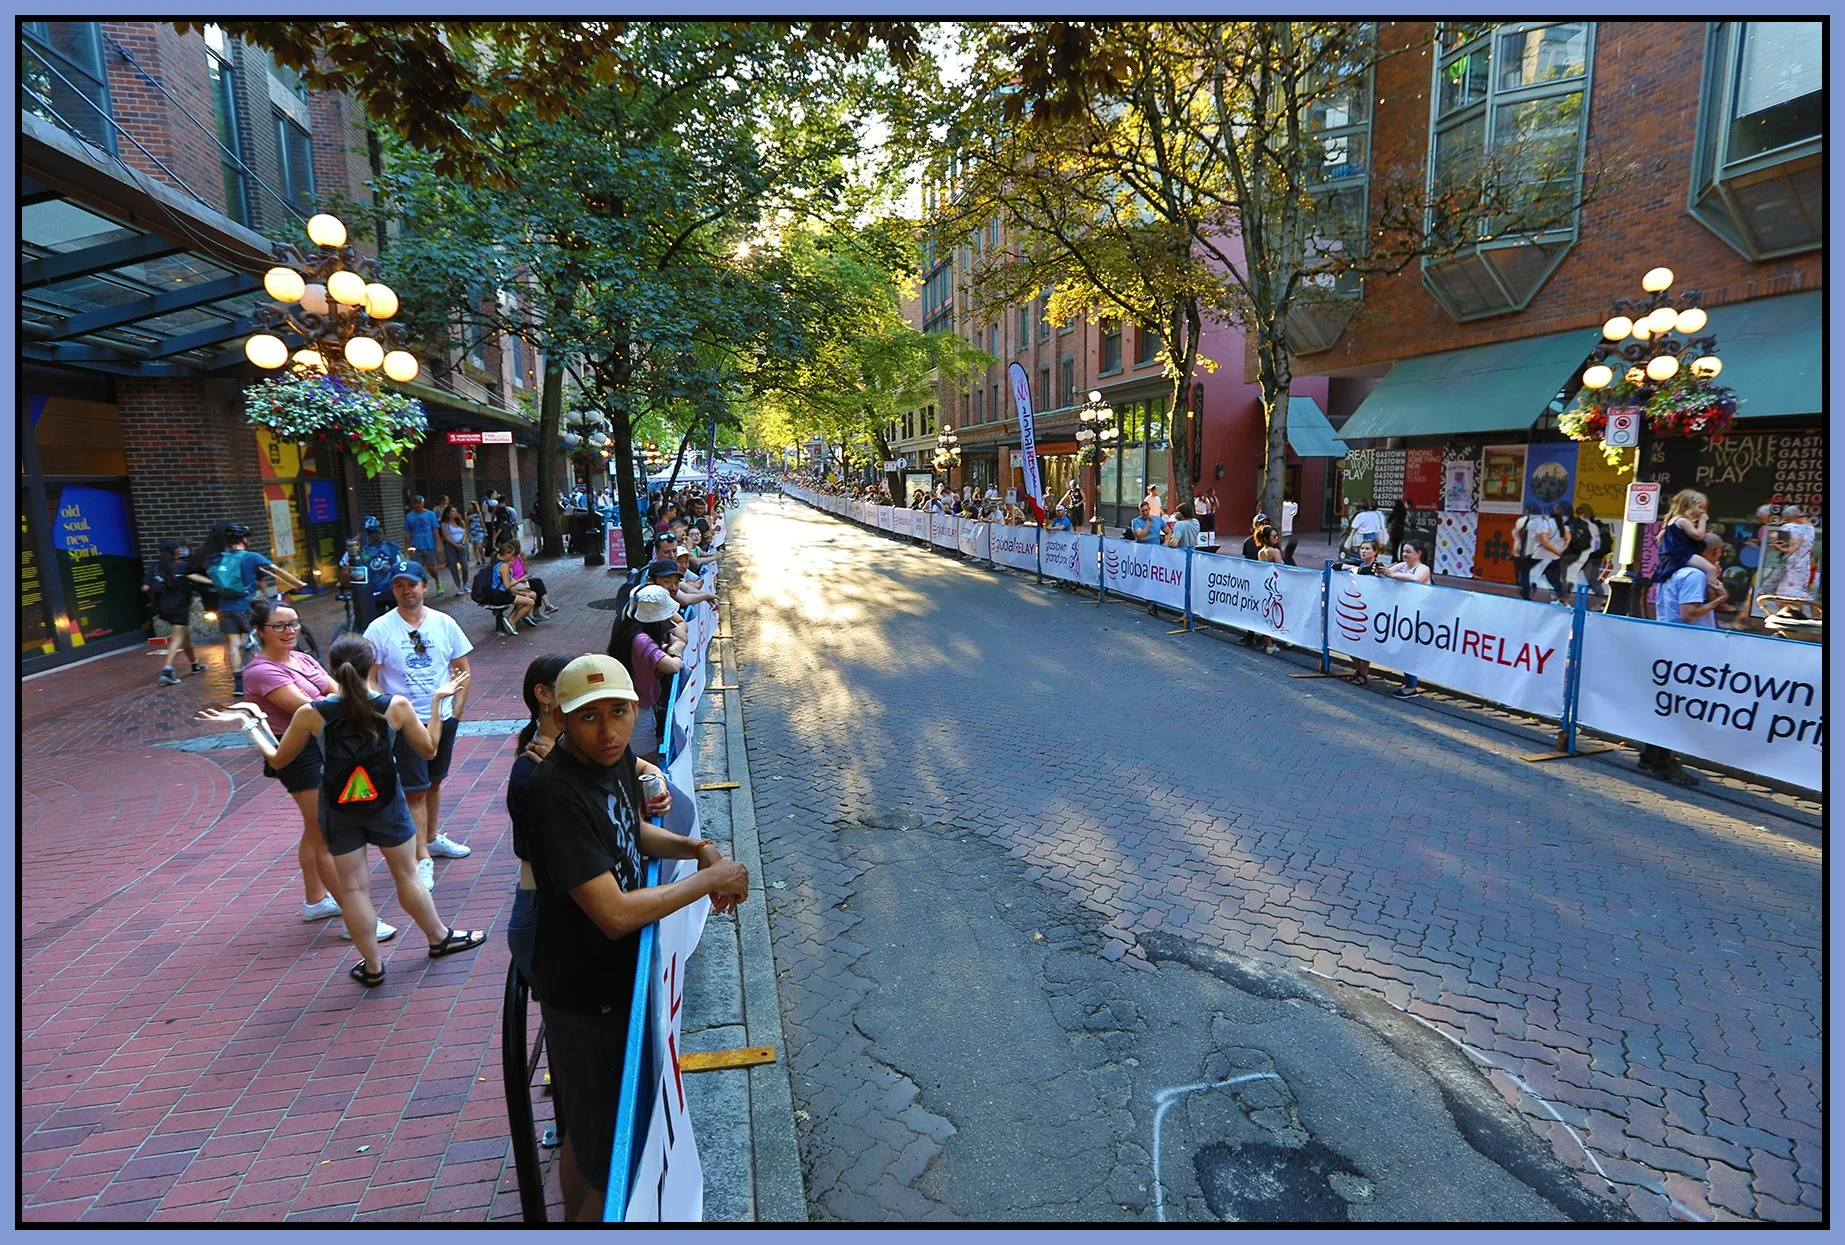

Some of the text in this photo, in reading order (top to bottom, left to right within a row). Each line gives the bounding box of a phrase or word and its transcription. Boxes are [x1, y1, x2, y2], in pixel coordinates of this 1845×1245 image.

[1780, 437, 1822, 448] GAST
[1342, 468, 1366, 480] PLAY
[1696, 464, 1752, 483] PLAY
[1773, 482, 1822, 492] GASTO
[61, 504, 80, 518] old
[63, 517, 91, 531] soul.
[66, 535, 89, 545] new
[68, 544, 102, 562] spirit.
[399, 561, 408, 572] S
[1208, 572, 1250, 591] gastown
[1208, 589, 1260, 611] grand prix
[1652, 658, 1815, 707] gastown
[1654, 690, 1822, 746] grand pri
